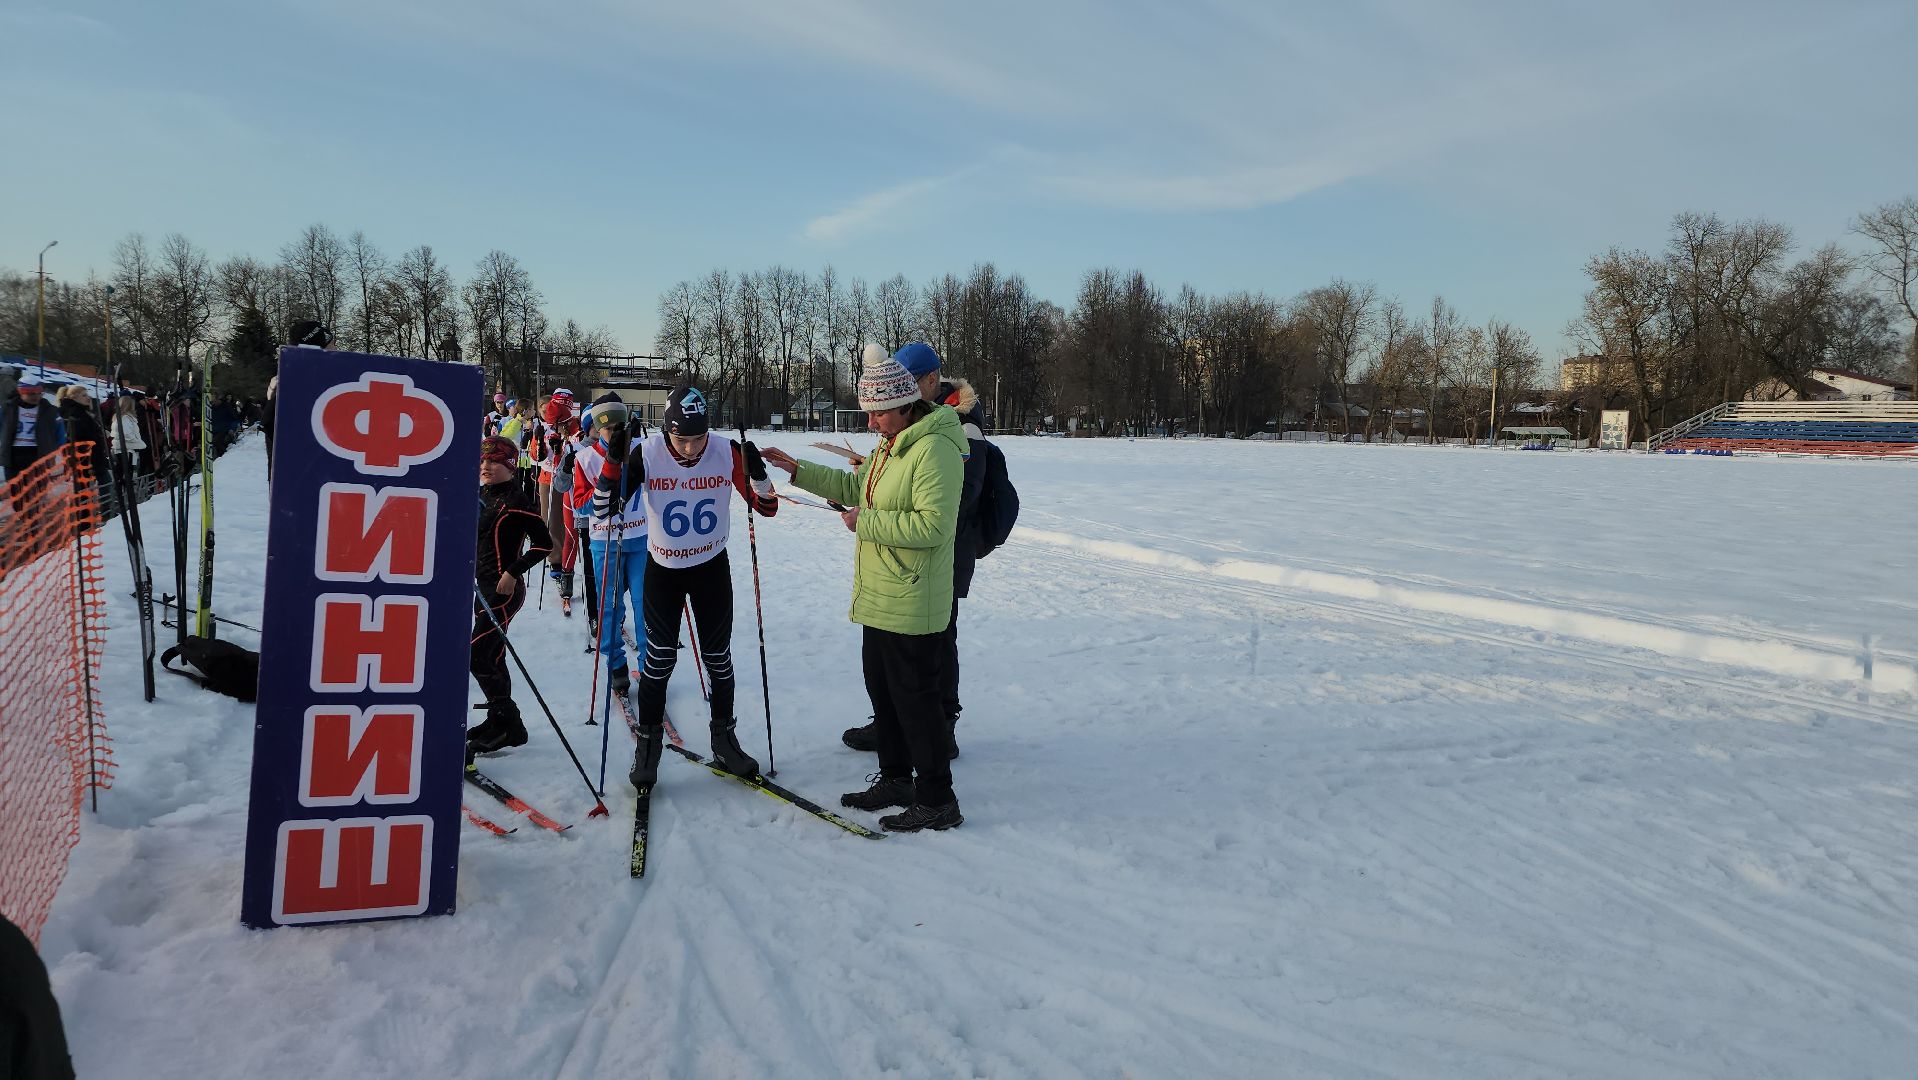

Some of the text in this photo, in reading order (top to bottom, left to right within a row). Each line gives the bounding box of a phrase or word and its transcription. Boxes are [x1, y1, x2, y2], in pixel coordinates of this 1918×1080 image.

[649, 476, 731, 491] МБУ «СШОР»
[663, 498, 718, 537] 66
[277, 375, 450, 920] ФИНИШ
